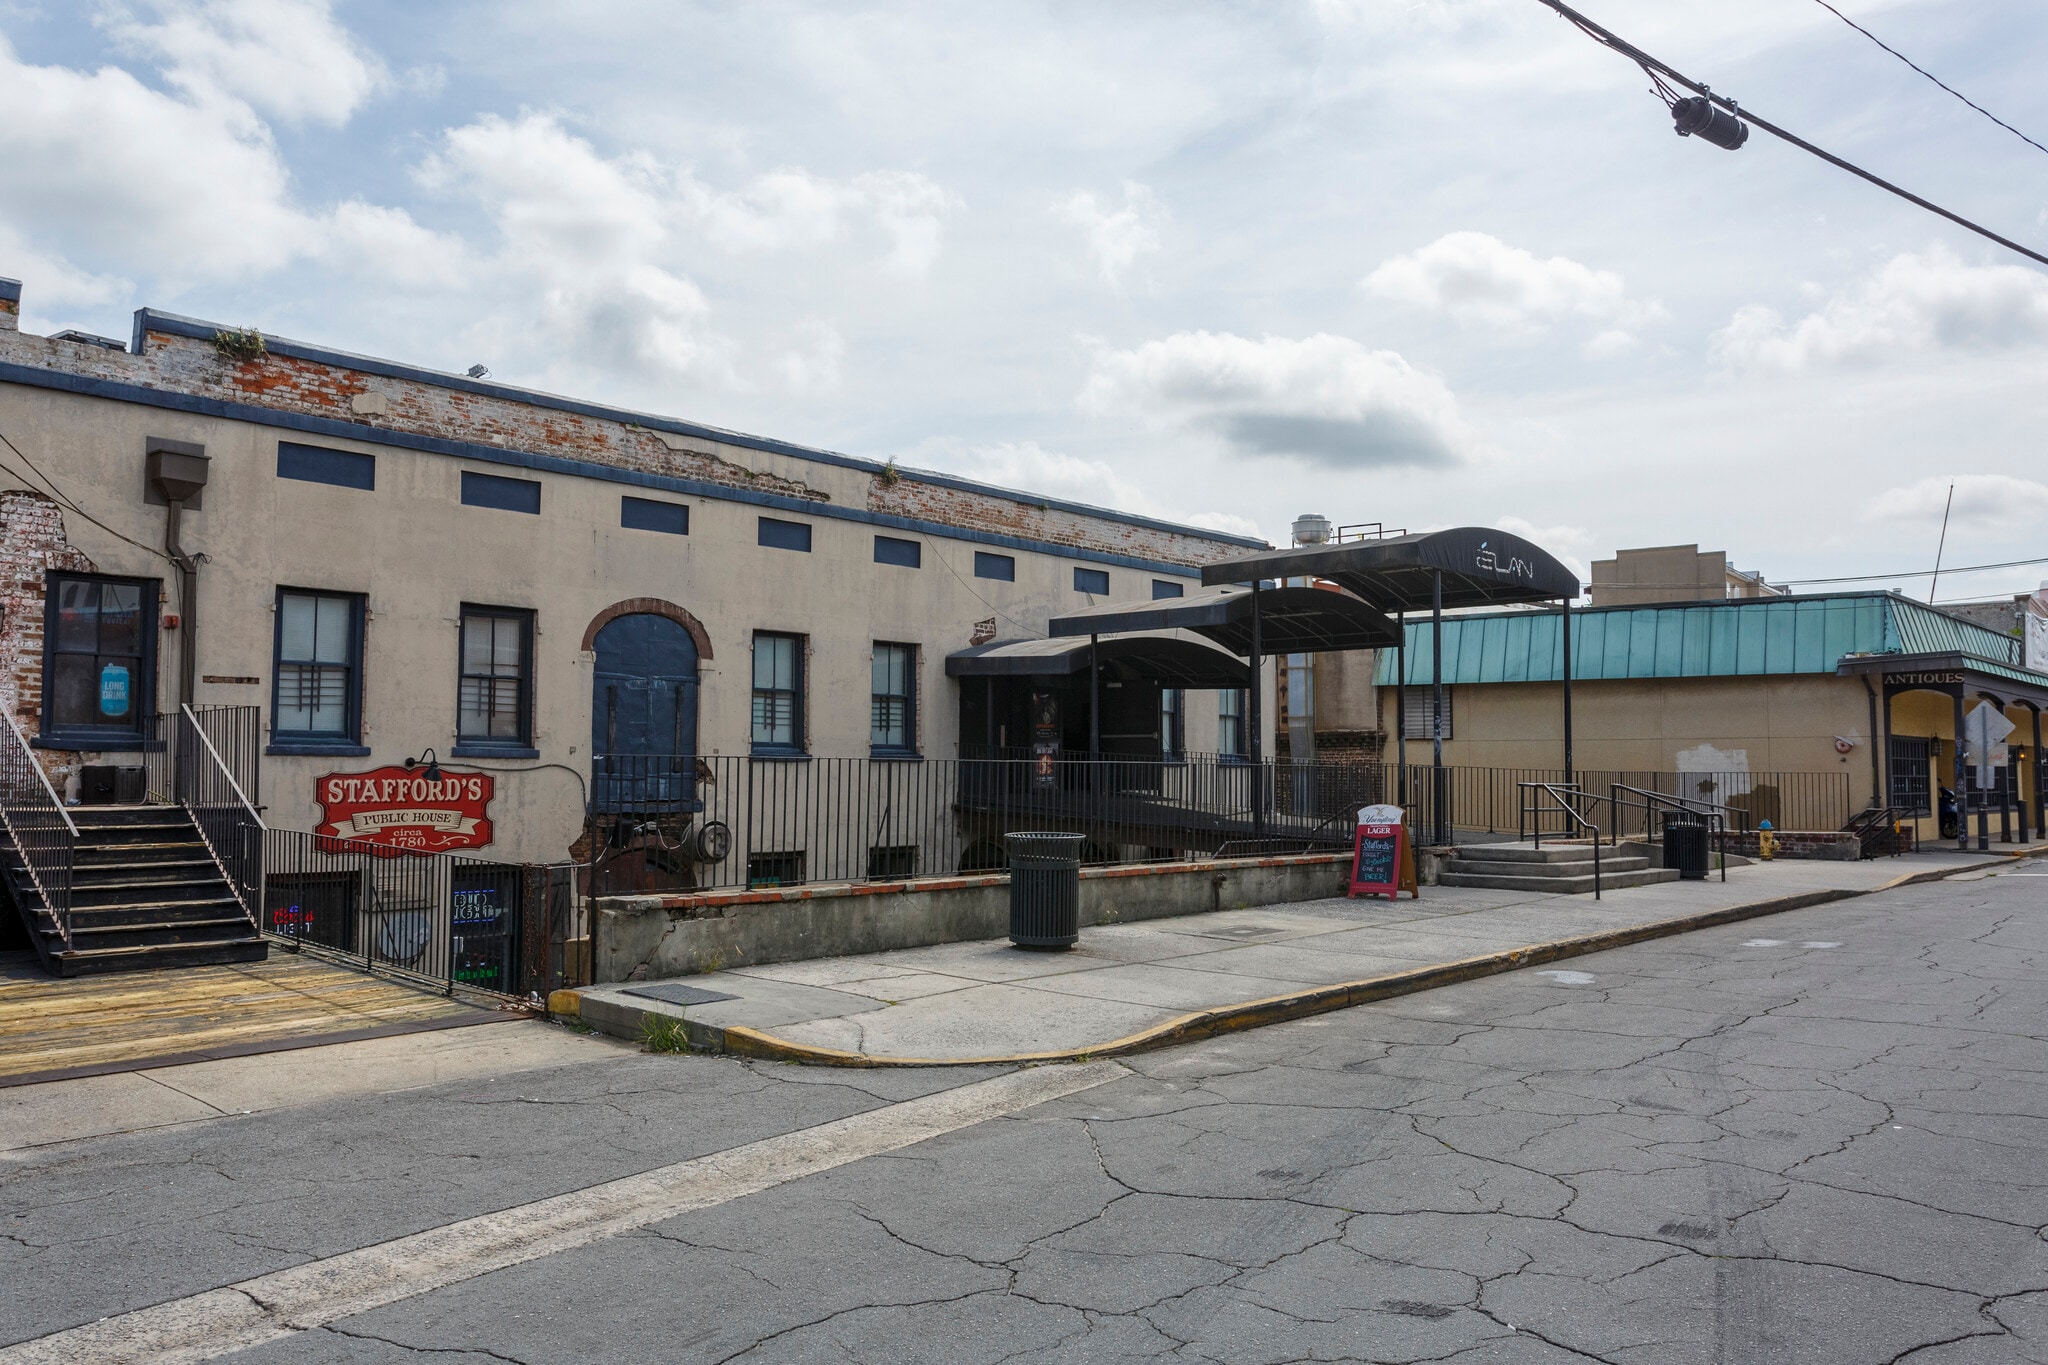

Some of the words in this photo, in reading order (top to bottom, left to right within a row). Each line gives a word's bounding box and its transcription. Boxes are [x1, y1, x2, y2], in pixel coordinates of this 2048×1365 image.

[1884, 672, 1965, 684] ANTIQUES
[104, 681, 125, 691] LONG
[102, 690, 127, 700] DRINK
[328, 778, 482, 803] STAFFORD'S
[363, 812, 408, 825] PUBLIC
[413, 811, 452, 823] HOUSE
[393, 828, 423, 837] circa
[390, 836, 426, 848] 1780
